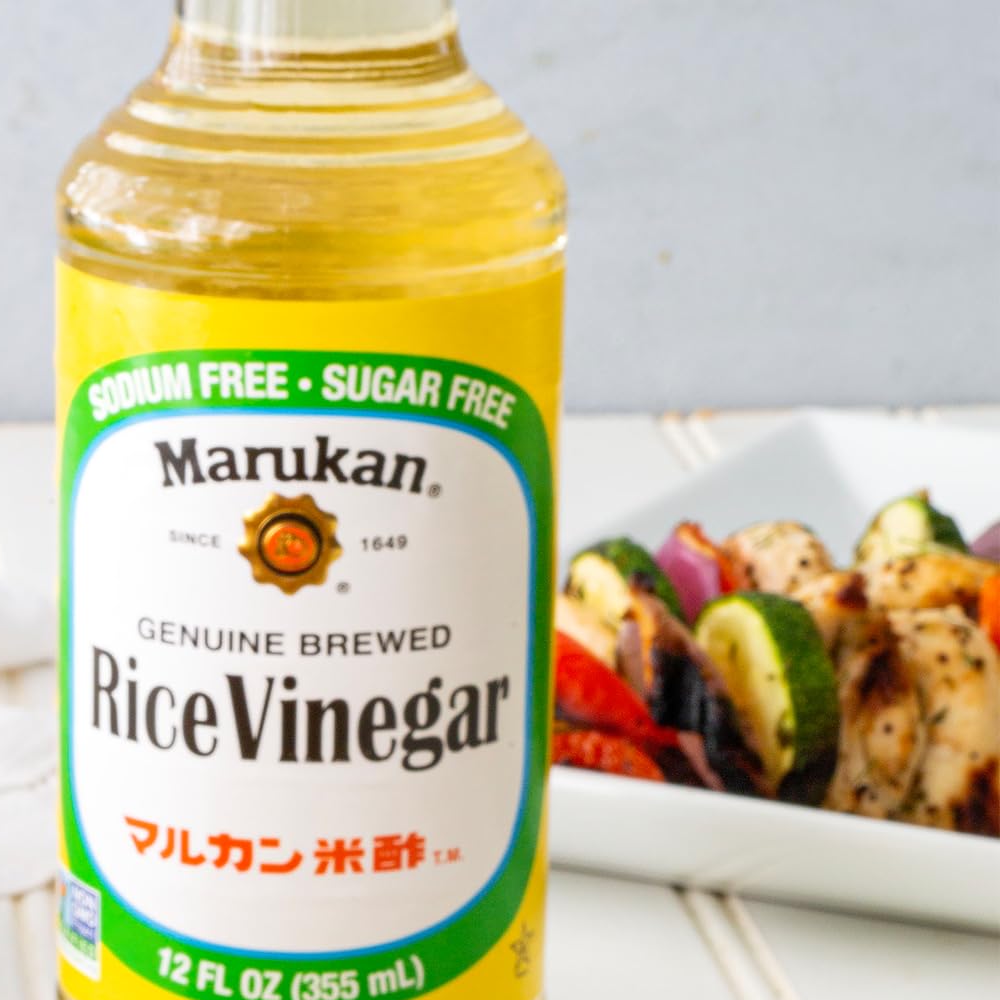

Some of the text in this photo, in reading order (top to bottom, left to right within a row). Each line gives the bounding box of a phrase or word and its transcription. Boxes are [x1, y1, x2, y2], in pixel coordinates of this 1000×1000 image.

[88, 362, 516, 429] SODIUM FREE SUGAR FREE
[155, 436, 427, 494] Marukan
[169, 530, 408, 551] SINCE 1649
[138, 617, 451, 656] GENUINE BREWED
[92, 645, 510, 772] Rice Vinegar
[157, 947, 190, 985] 12
[196, 964, 231, 997] FL
[368, 954, 425, 995] mL)
